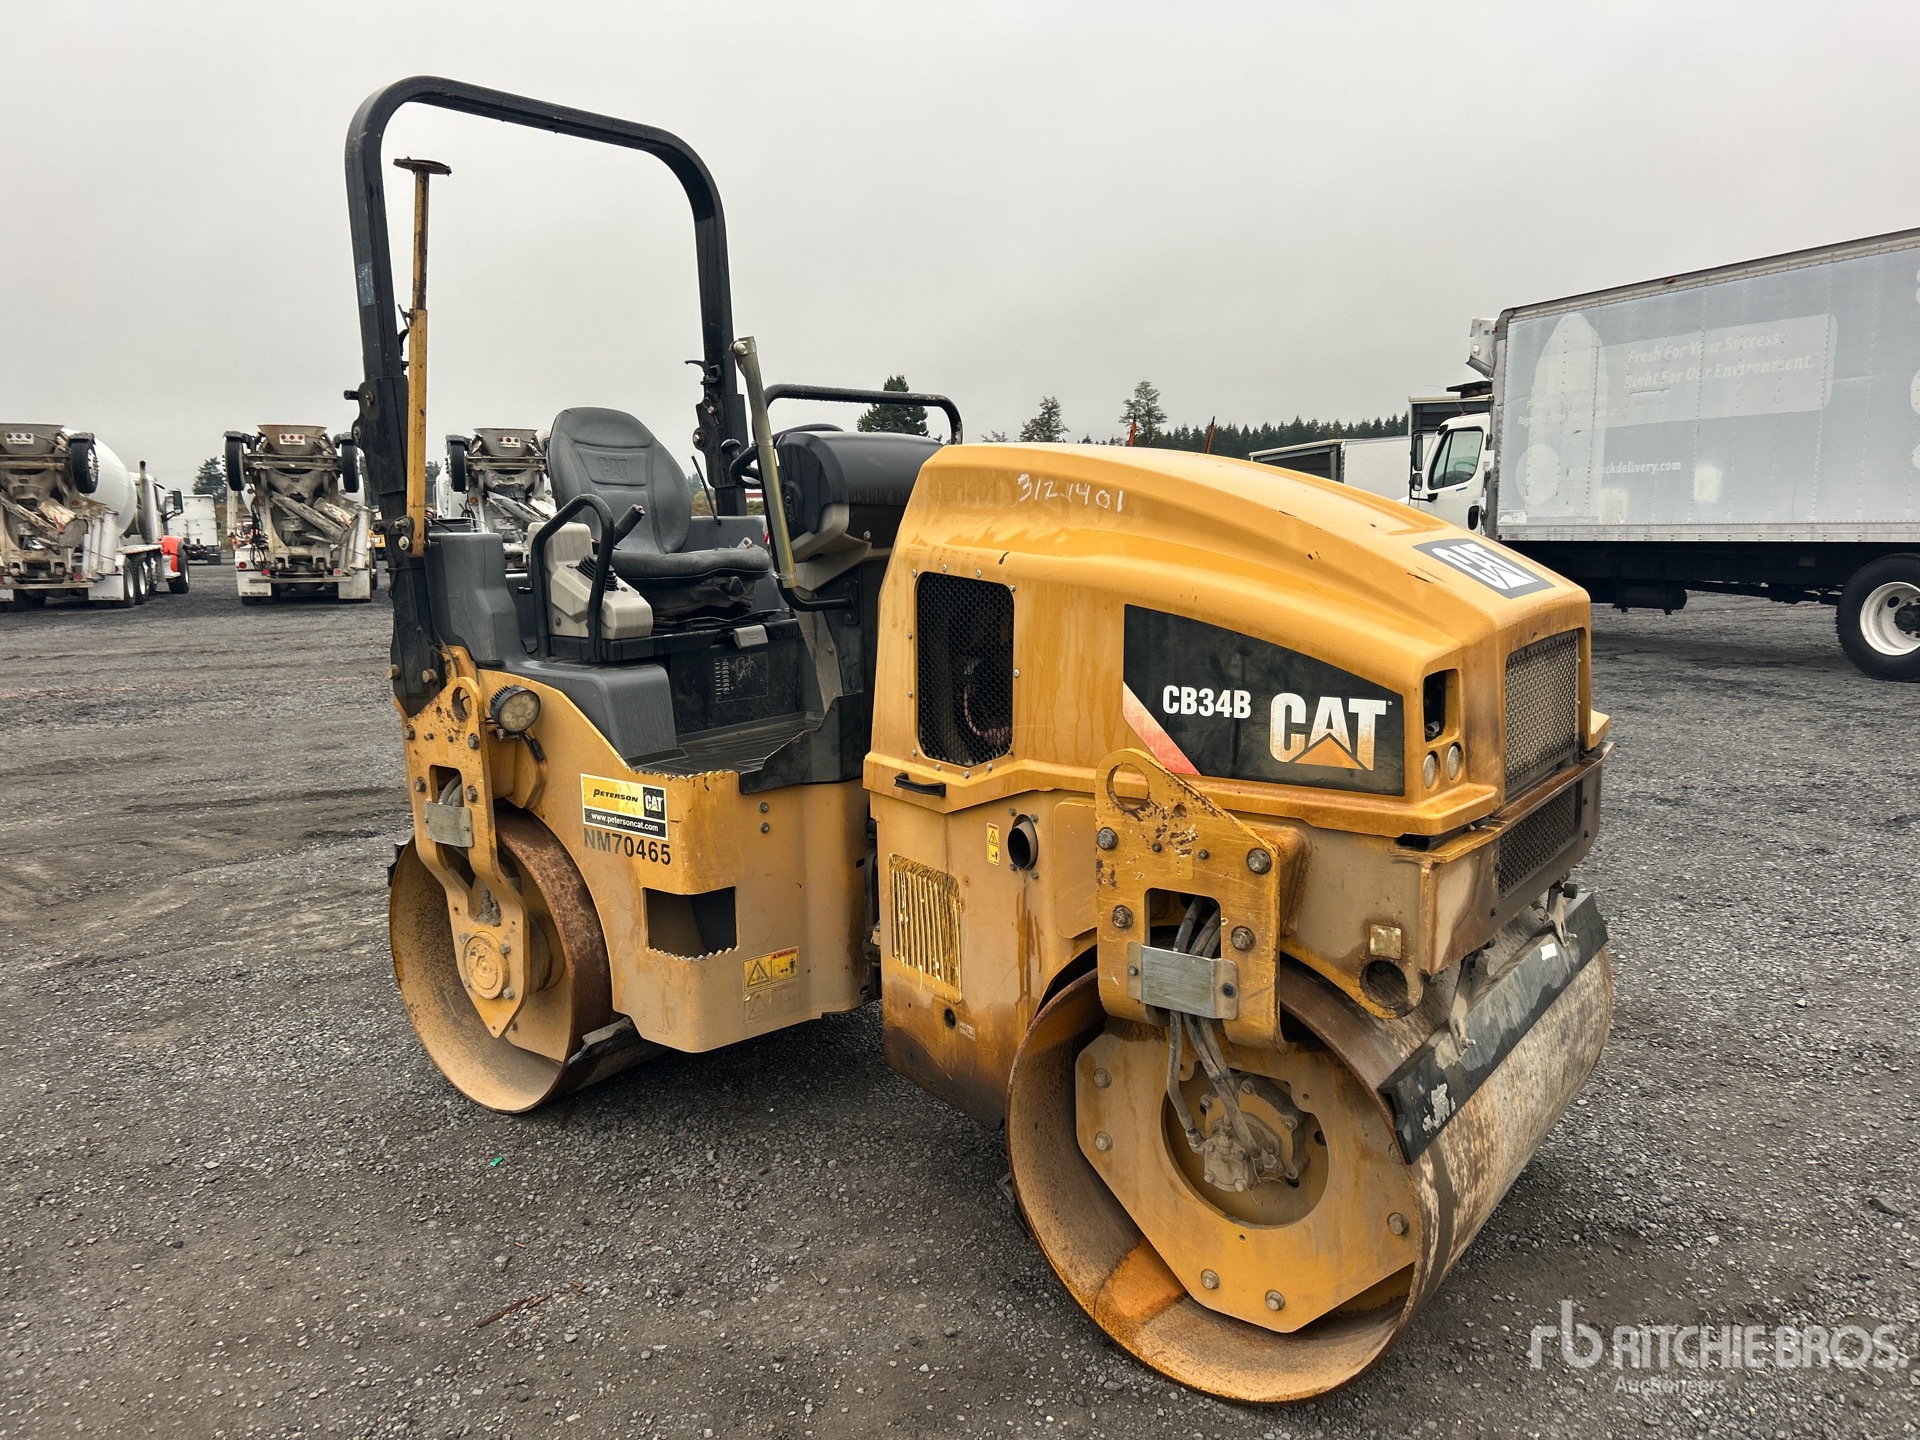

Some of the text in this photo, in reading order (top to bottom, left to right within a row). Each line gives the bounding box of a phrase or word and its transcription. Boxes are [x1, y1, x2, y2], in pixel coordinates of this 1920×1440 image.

[1627, 345, 1660, 364] Fresh
[1663, 345, 1687, 359] For
[1690, 341, 1722, 355] Your
[1624, 369, 1660, 391] Right
[1661, 370, 1683, 385] For
[1686, 367, 1713, 381] Our
[597, 456, 629, 481] CAT
[1431, 543, 1538, 590] CAT
[1162, 685, 1387, 771] CB34B CAT
[593, 788, 664, 813] PETERSON CAT
[590, 812, 659, 832] www.petersoncat.com
[583, 827, 671, 866] NM70465
